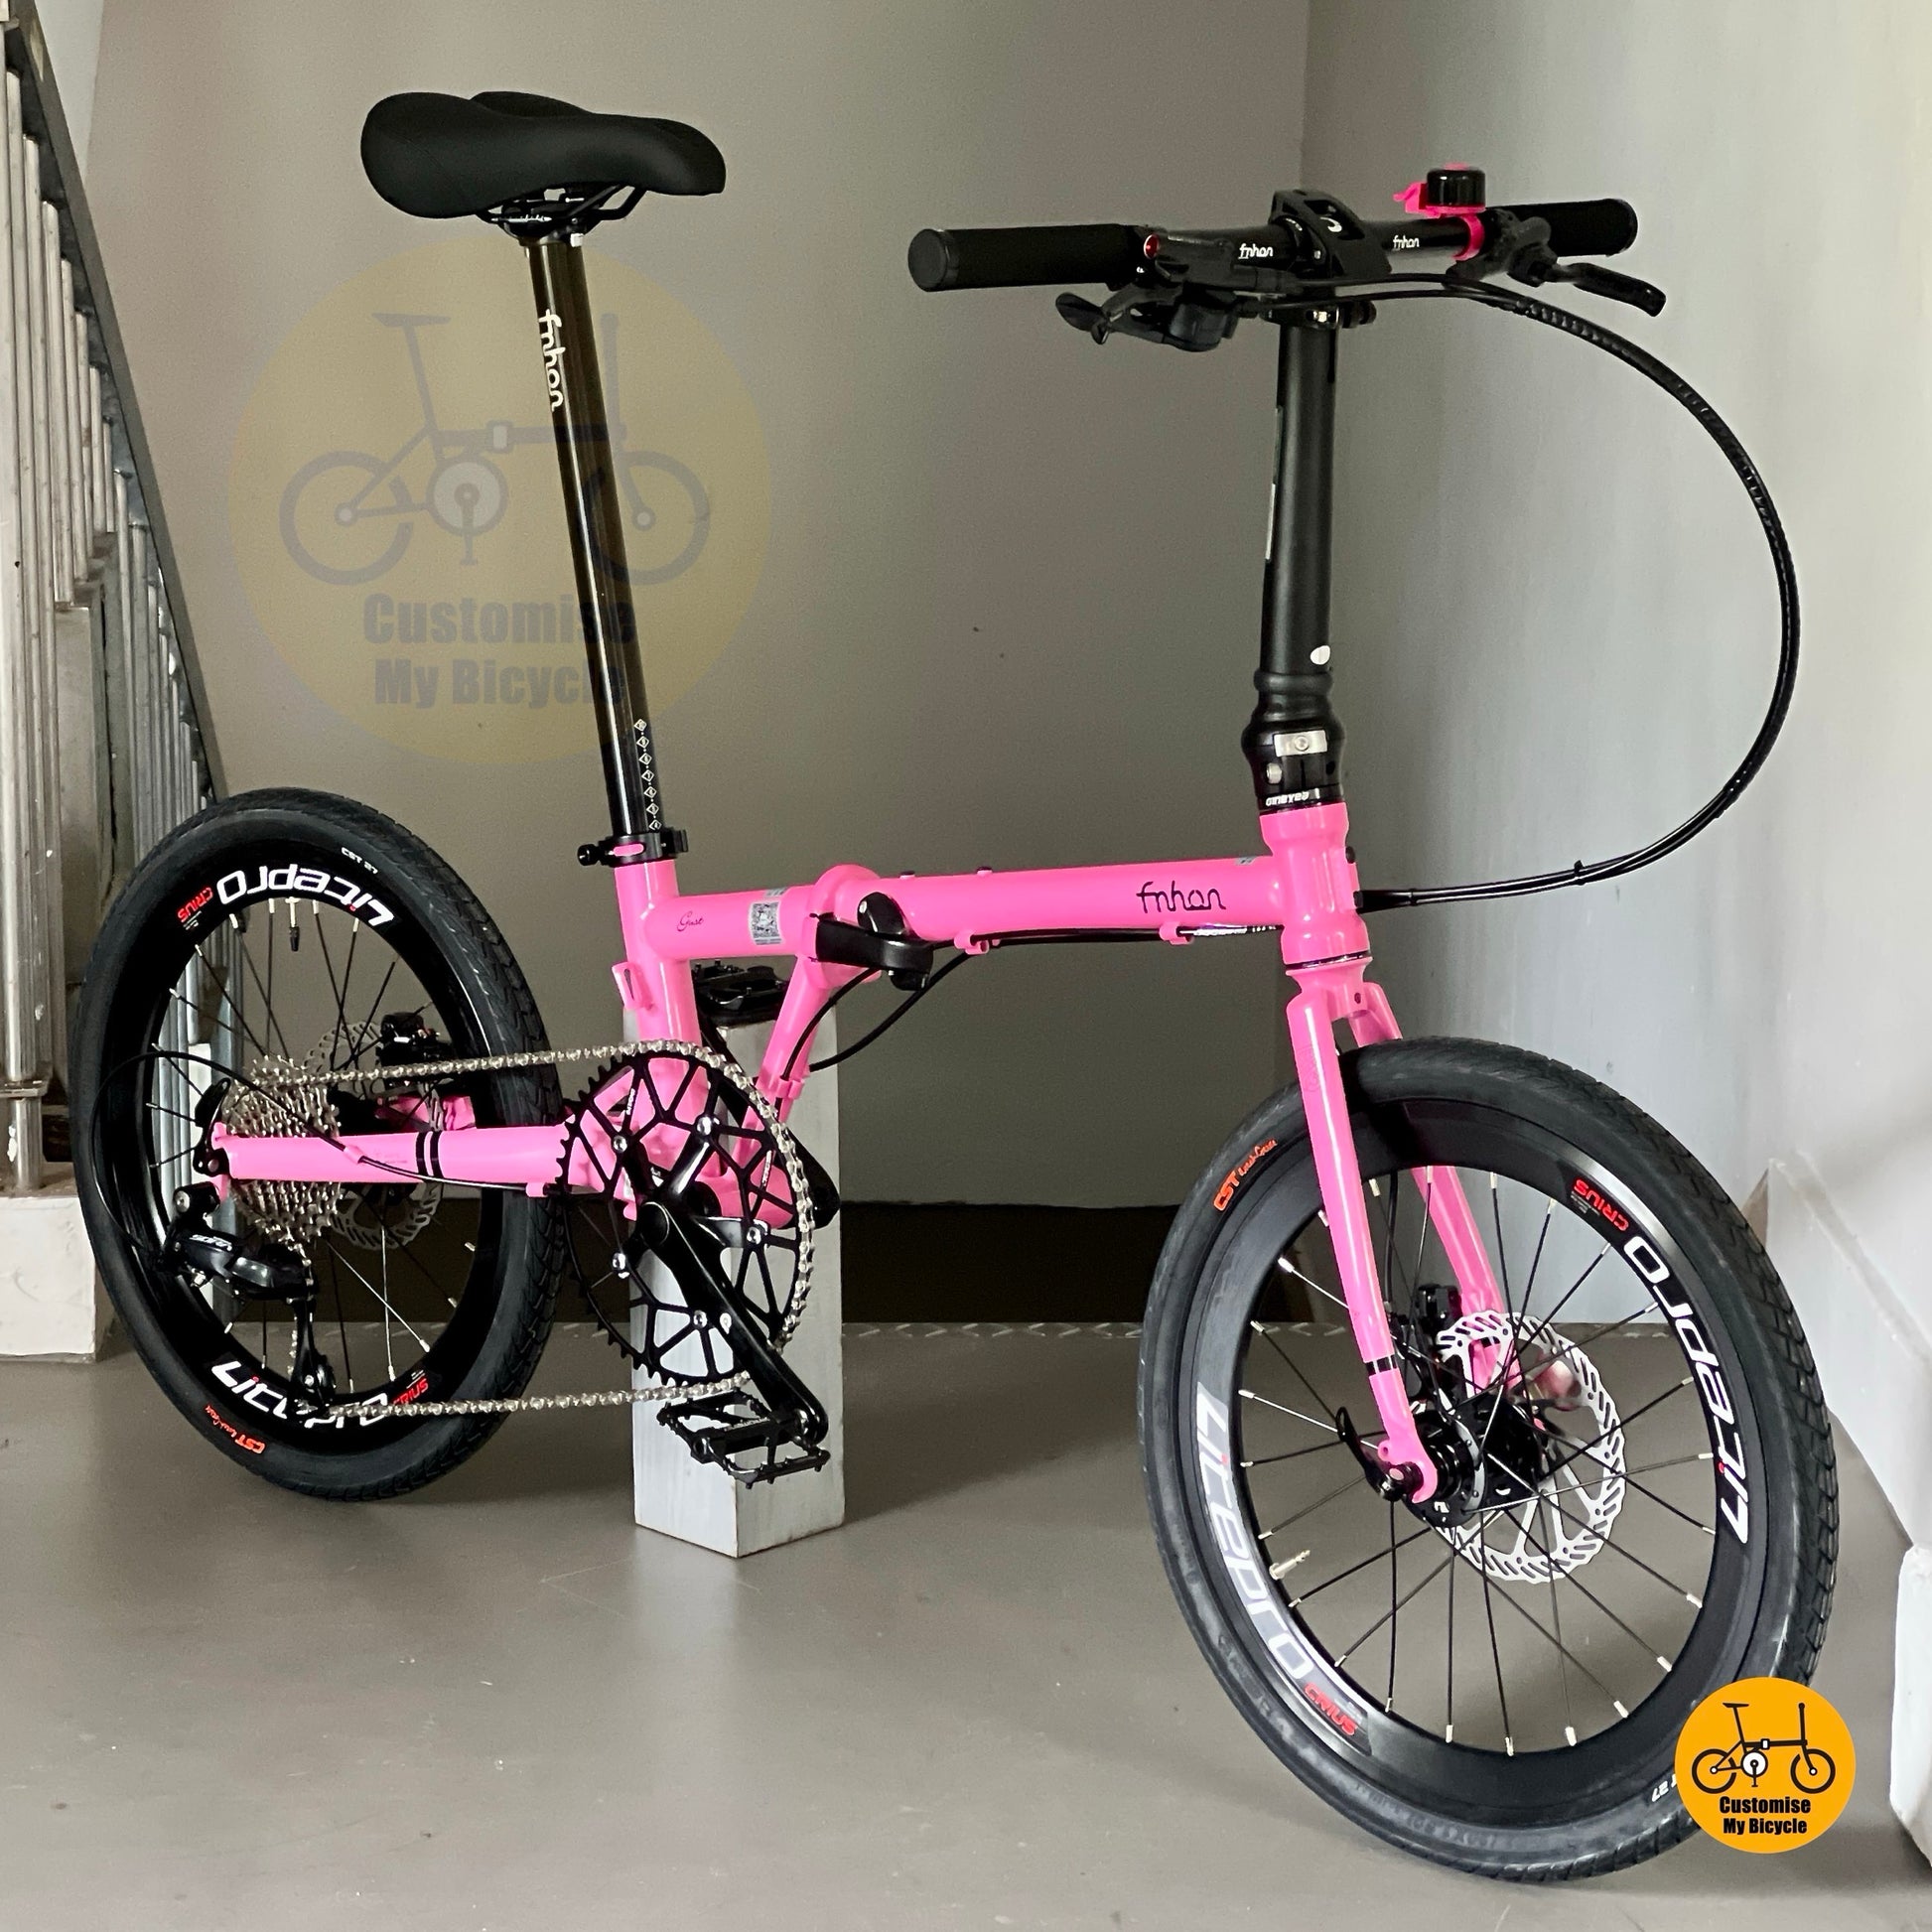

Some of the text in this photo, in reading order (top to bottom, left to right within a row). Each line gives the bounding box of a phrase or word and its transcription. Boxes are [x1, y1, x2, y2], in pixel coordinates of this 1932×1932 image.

[177, 887, 213, 922] CRIUS
[1136, 881, 1226, 913] fnhon
[1213, 1170, 1240, 1211] CST
[1573, 1178, 1629, 1231] CRIUS
[1305, 1682, 1358, 1735] CRIUS
